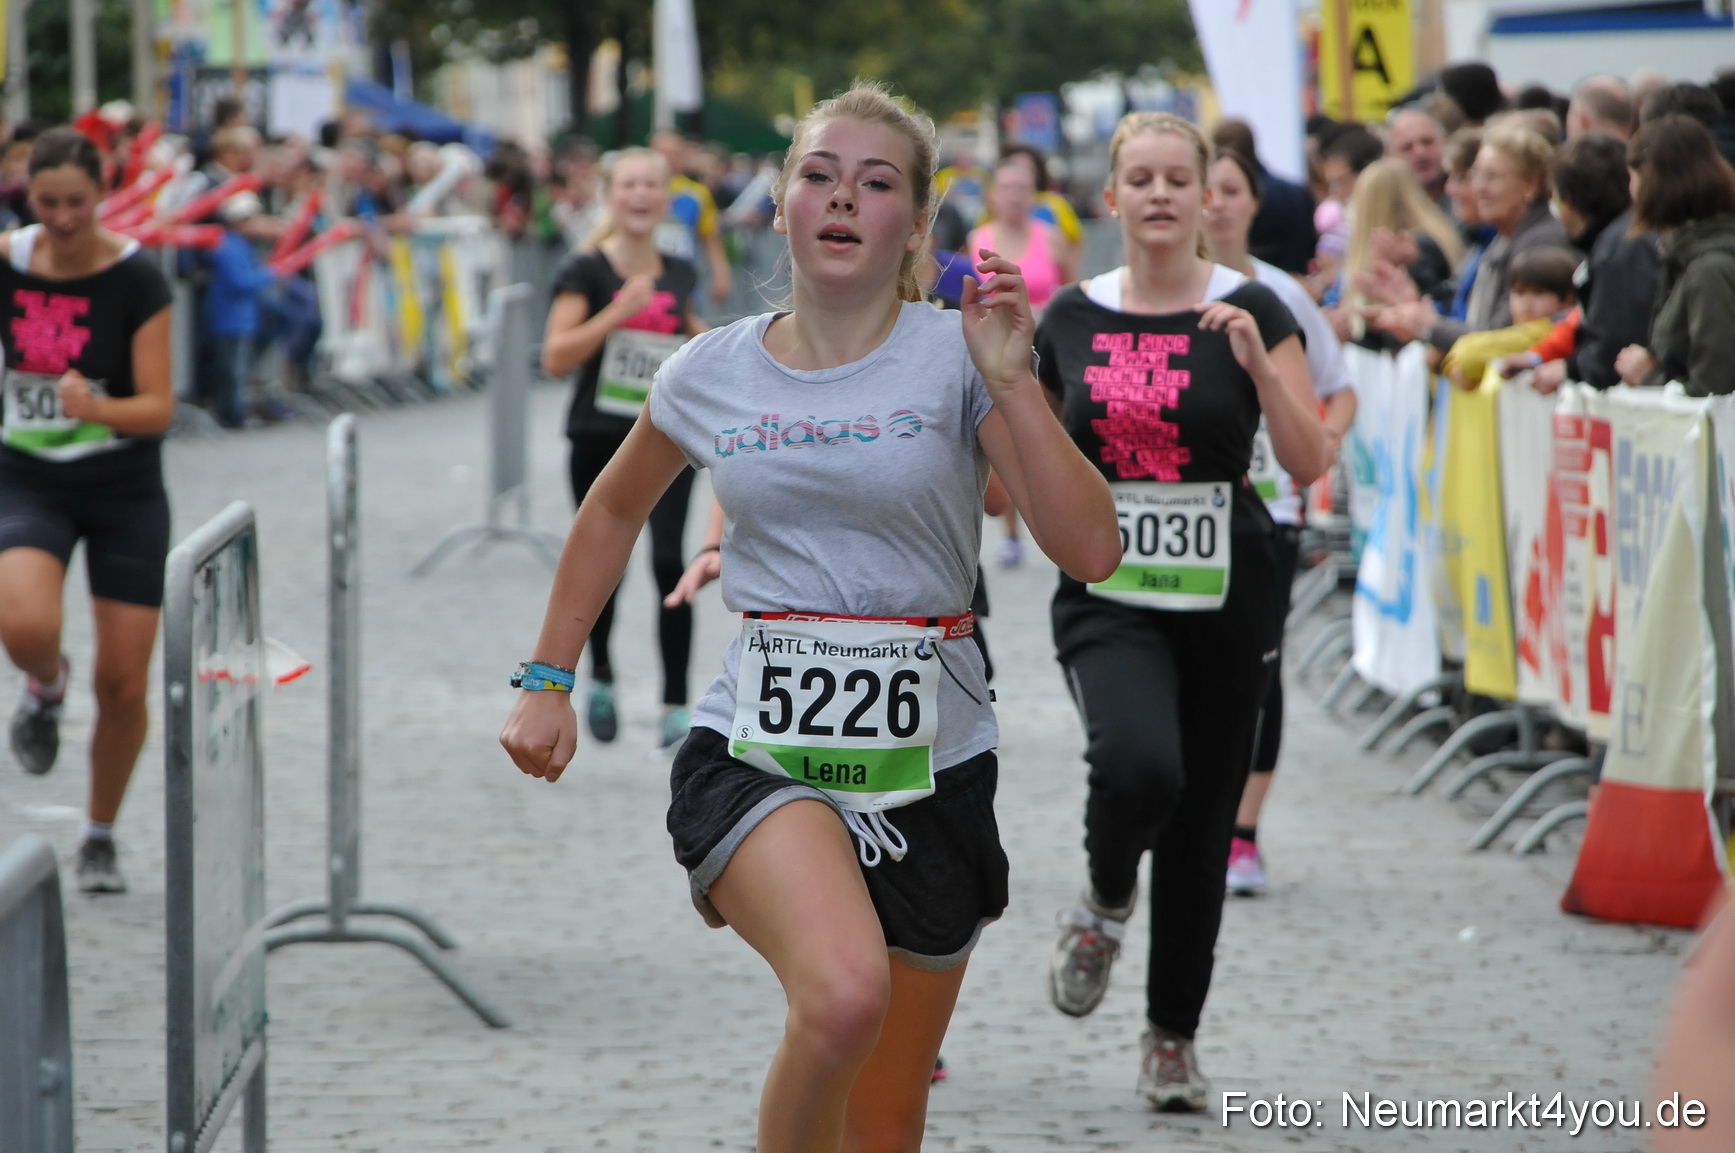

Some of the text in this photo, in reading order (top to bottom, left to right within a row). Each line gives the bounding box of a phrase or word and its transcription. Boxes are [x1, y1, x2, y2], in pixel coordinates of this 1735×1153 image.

[1350, 26, 1391, 85] A
[1092, 333, 1190, 354] WIR SIND
[1110, 351, 1168, 369] ZWAR
[1085, 366, 1190, 387] NICHT DIE
[714, 413, 881, 459] adidas
[1144, 493, 1207, 506] Neumarkt
[1117, 510, 1216, 559] 5030
[1138, 571, 1180, 589] Jana
[812, 639, 909, 659] Neumarkt
[758, 665, 921, 739] 5226
[803, 756, 867, 785] Lena
